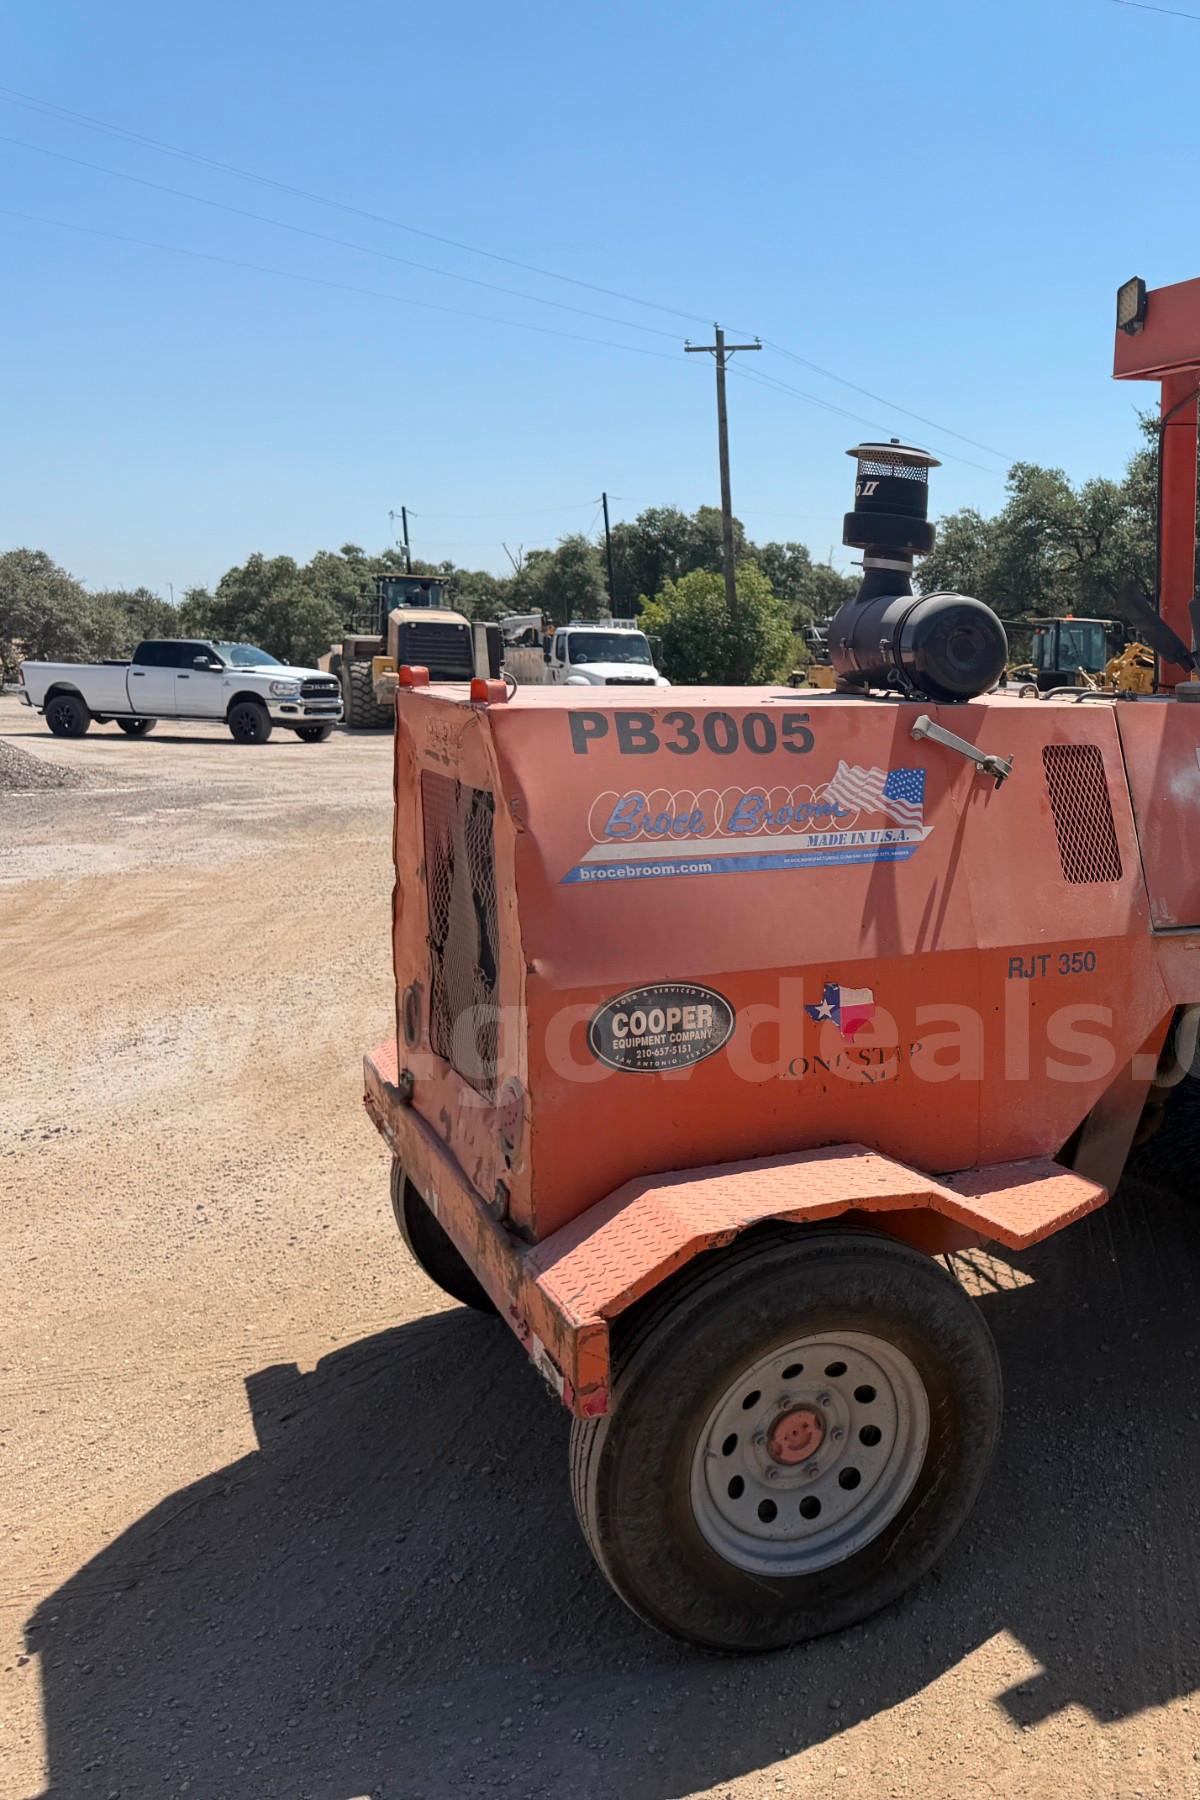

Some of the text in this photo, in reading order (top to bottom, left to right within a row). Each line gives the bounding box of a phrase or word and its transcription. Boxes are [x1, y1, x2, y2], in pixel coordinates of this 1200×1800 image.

[568, 711, 815, 755] PB3005
[727, 795, 850, 832] Broom
[806, 830, 910, 847] MADE IN U.S.A.
[580, 861, 712, 880] brocebroom.com
[1008, 951, 1096, 979] RJT 350
[615, 994, 637, 1008] SOLD
[654, 987, 696, 995] SERVICED
[612, 1004, 713, 1038] COOPER
[613, 1028, 713, 1050] EQUIPMENT COMPANY
[615, 1055, 632, 1065] SAN
[686, 1044, 712, 1061] TEXAS
[636, 1043, 692, 1059] 210-657-5151
